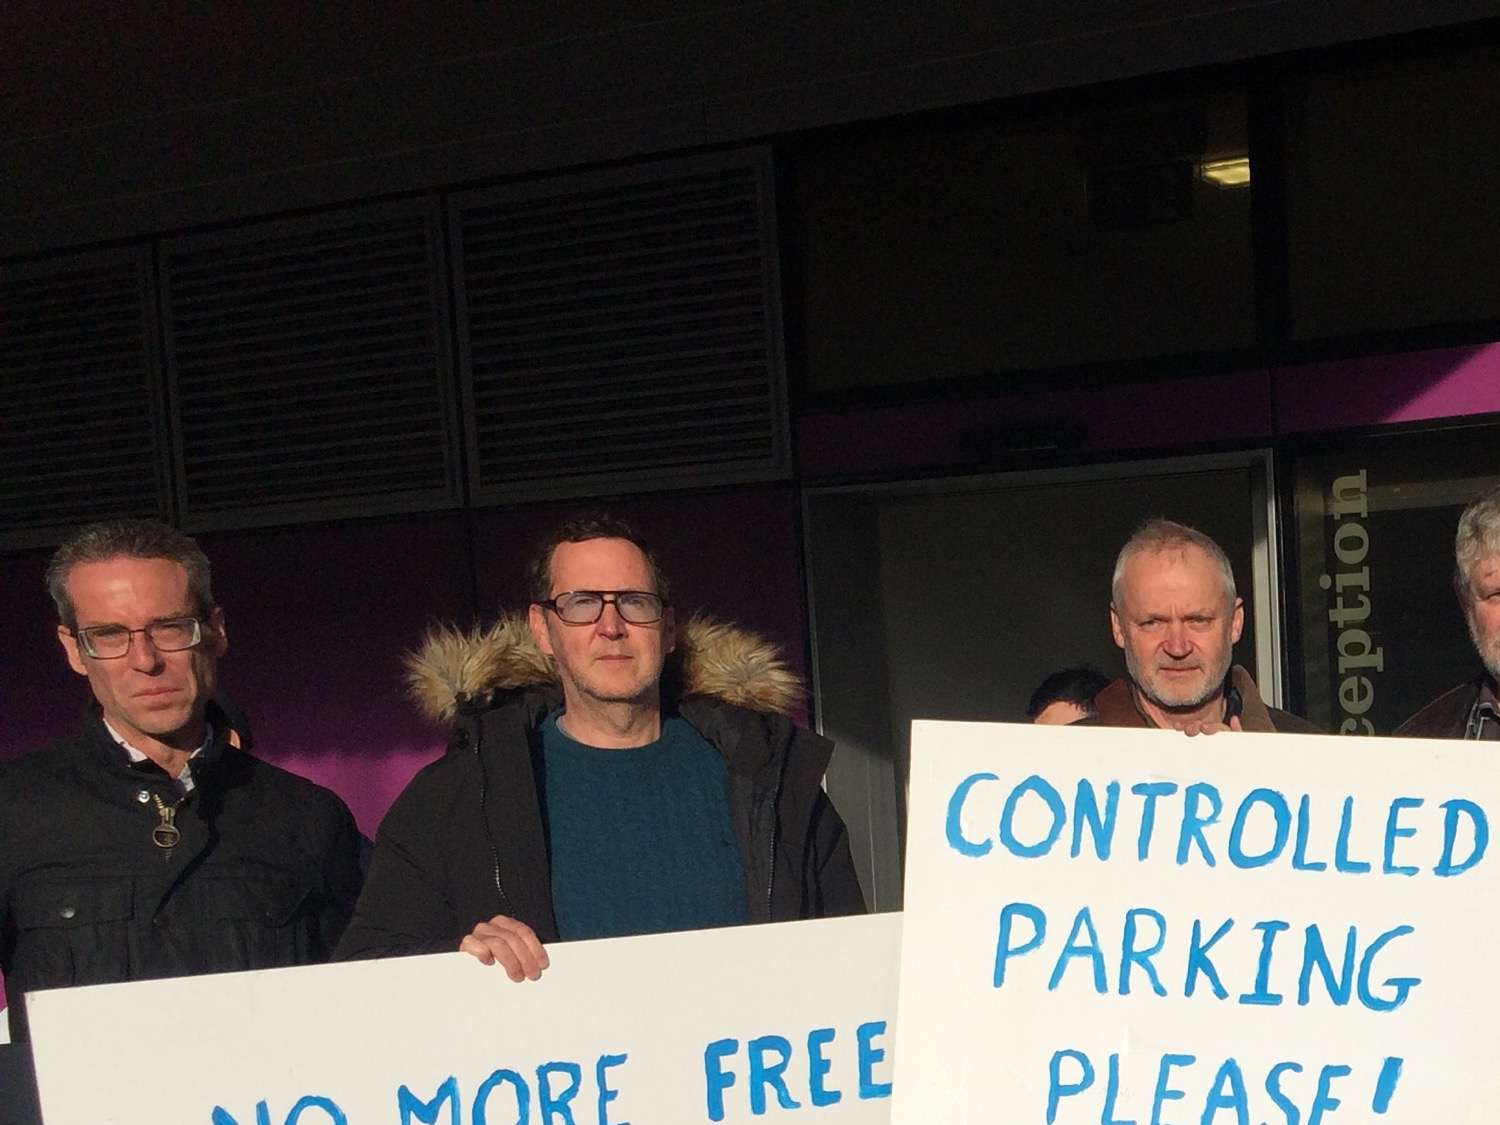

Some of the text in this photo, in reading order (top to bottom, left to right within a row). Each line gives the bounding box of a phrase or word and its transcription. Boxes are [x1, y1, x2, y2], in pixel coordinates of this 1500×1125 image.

[946, 773, 1488, 876] CONTROLLED
[994, 903, 1419, 1011] PARKING
[705, 1022, 891, 1121] FREE
